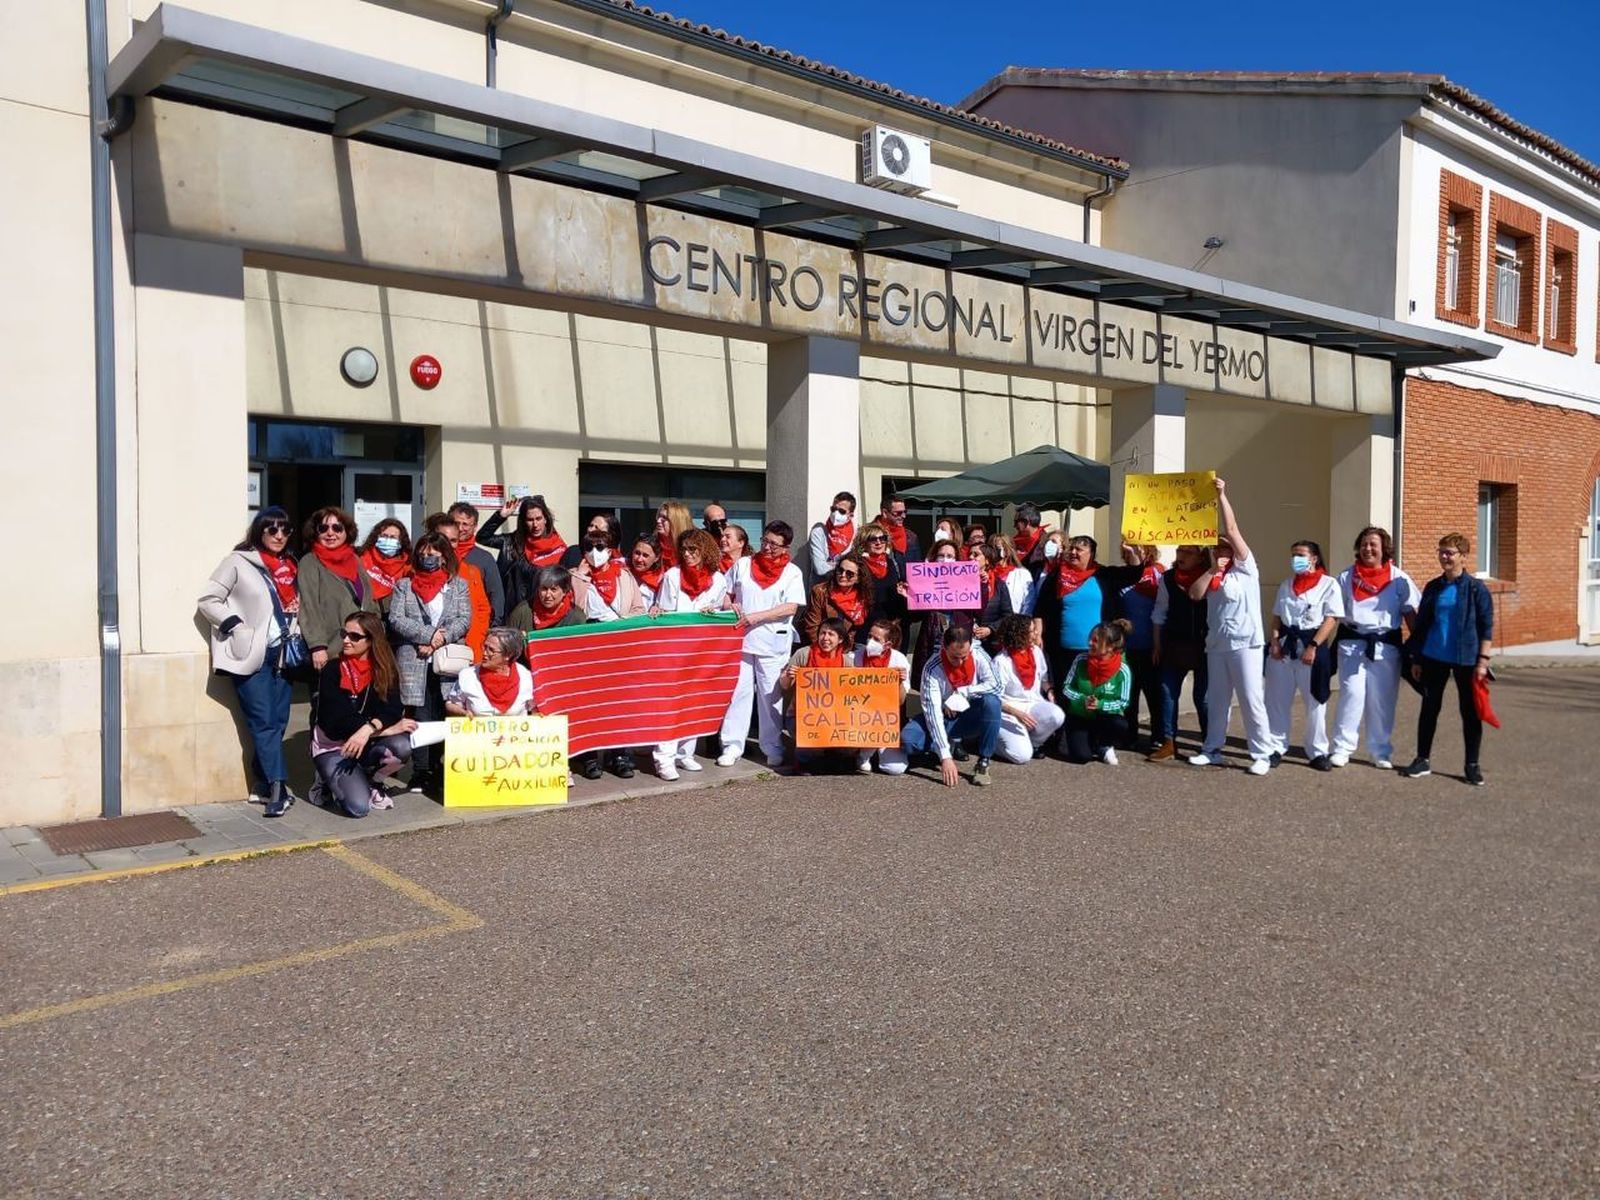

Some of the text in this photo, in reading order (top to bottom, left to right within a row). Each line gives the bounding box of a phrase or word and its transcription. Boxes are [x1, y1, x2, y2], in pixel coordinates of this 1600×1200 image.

[644, 235, 1266, 382] CENTRO REGIONAL VIRGEN DEL YERMO
[912, 564, 978, 577] SINDICATO
[800, 669, 829, 690] SIN
[806, 692, 871, 709] NO HAY
[803, 707, 899, 727] CALIDAD
[808, 731, 819, 739] DE
[450, 751, 565, 773] CUIDADOR
[497, 775, 566, 792] AUXILIAR
